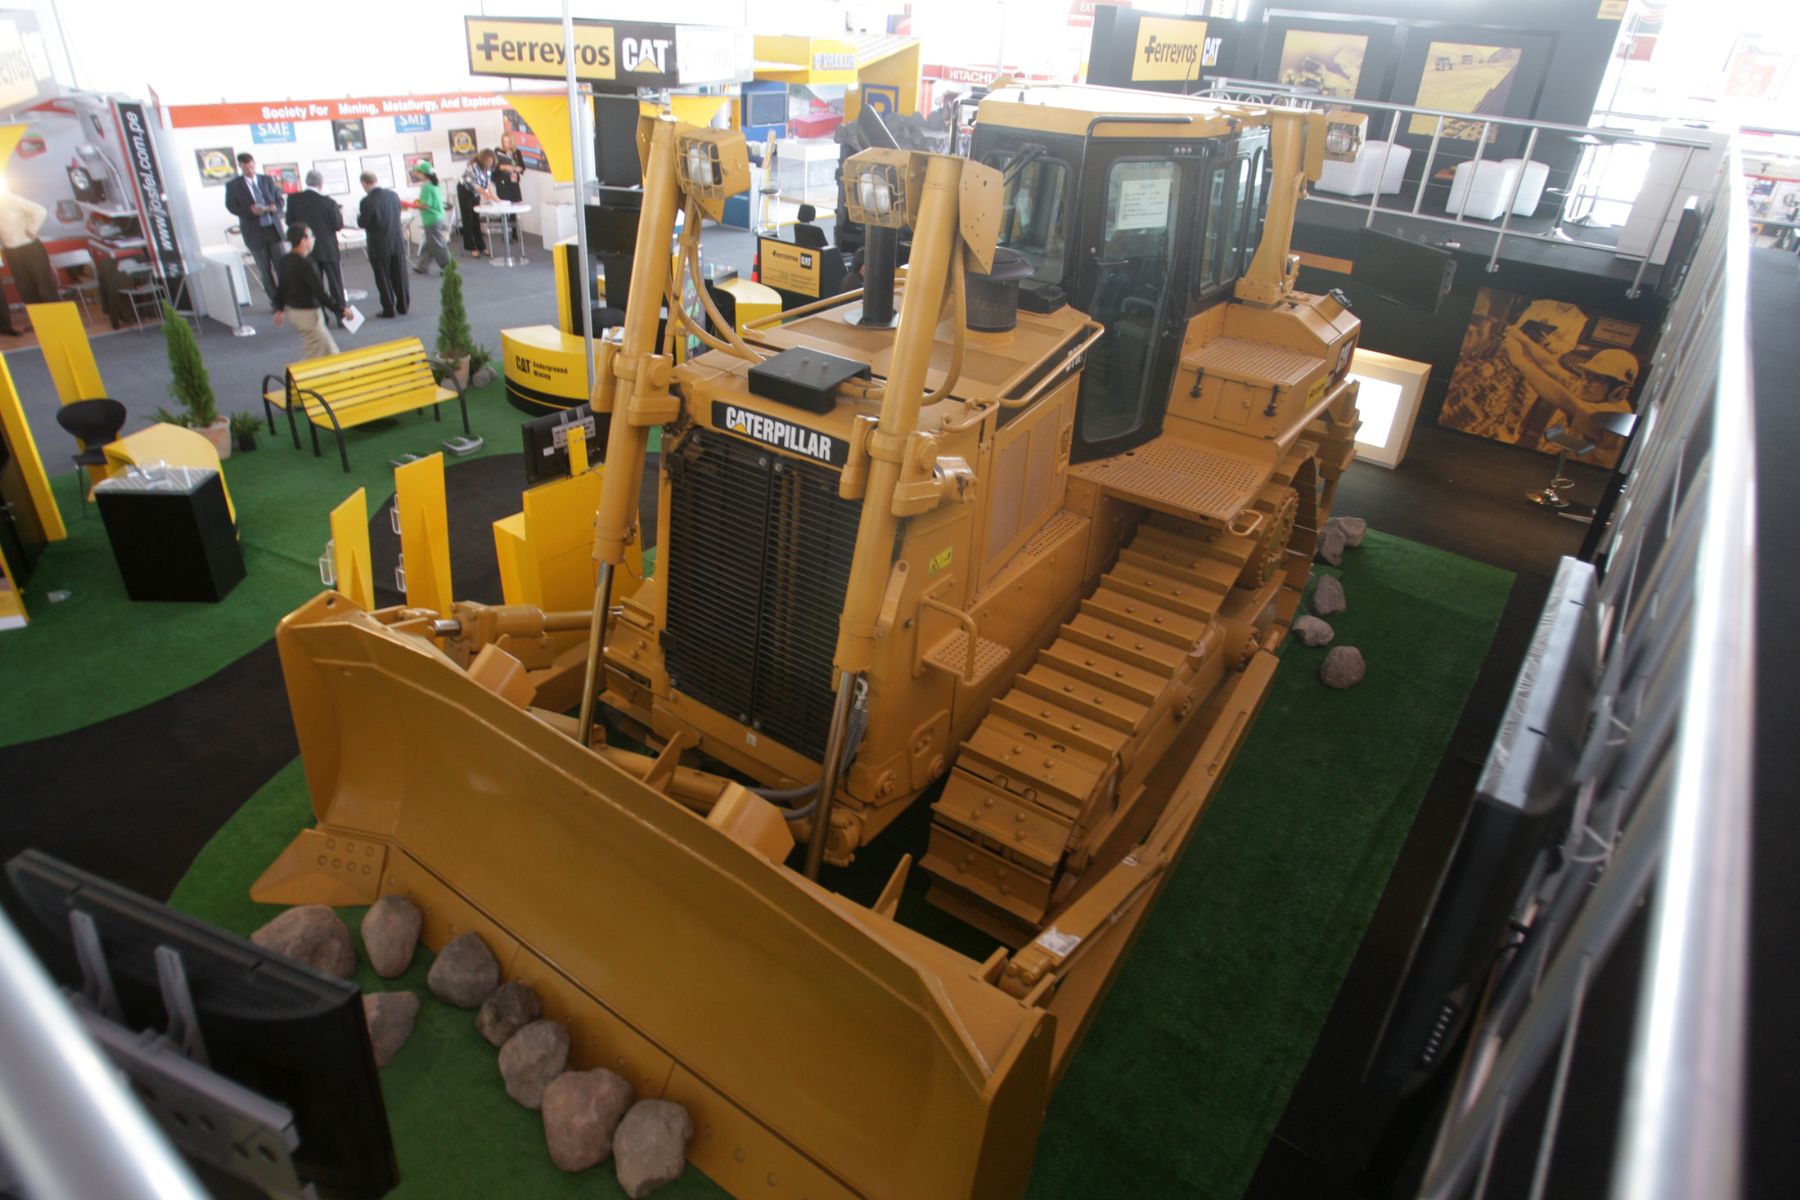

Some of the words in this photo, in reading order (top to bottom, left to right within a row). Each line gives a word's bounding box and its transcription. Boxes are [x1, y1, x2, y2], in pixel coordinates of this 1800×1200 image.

[476, 32, 611, 67] Ferreyros
[622, 37, 669, 74] CAT
[1144, 35, 1198, 64] Ferreyros
[1202, 37, 1223, 66] CAT
[950, 69, 993, 83] HITACHI
[262, 106, 307, 119] Society
[309, 104, 329, 116] For
[441, 97, 461, 109] And
[258, 122, 290, 137] SME
[400, 114, 426, 127] SME
[516, 355, 530, 374] CAT
[726, 406, 832, 461] CATERPILLAR
